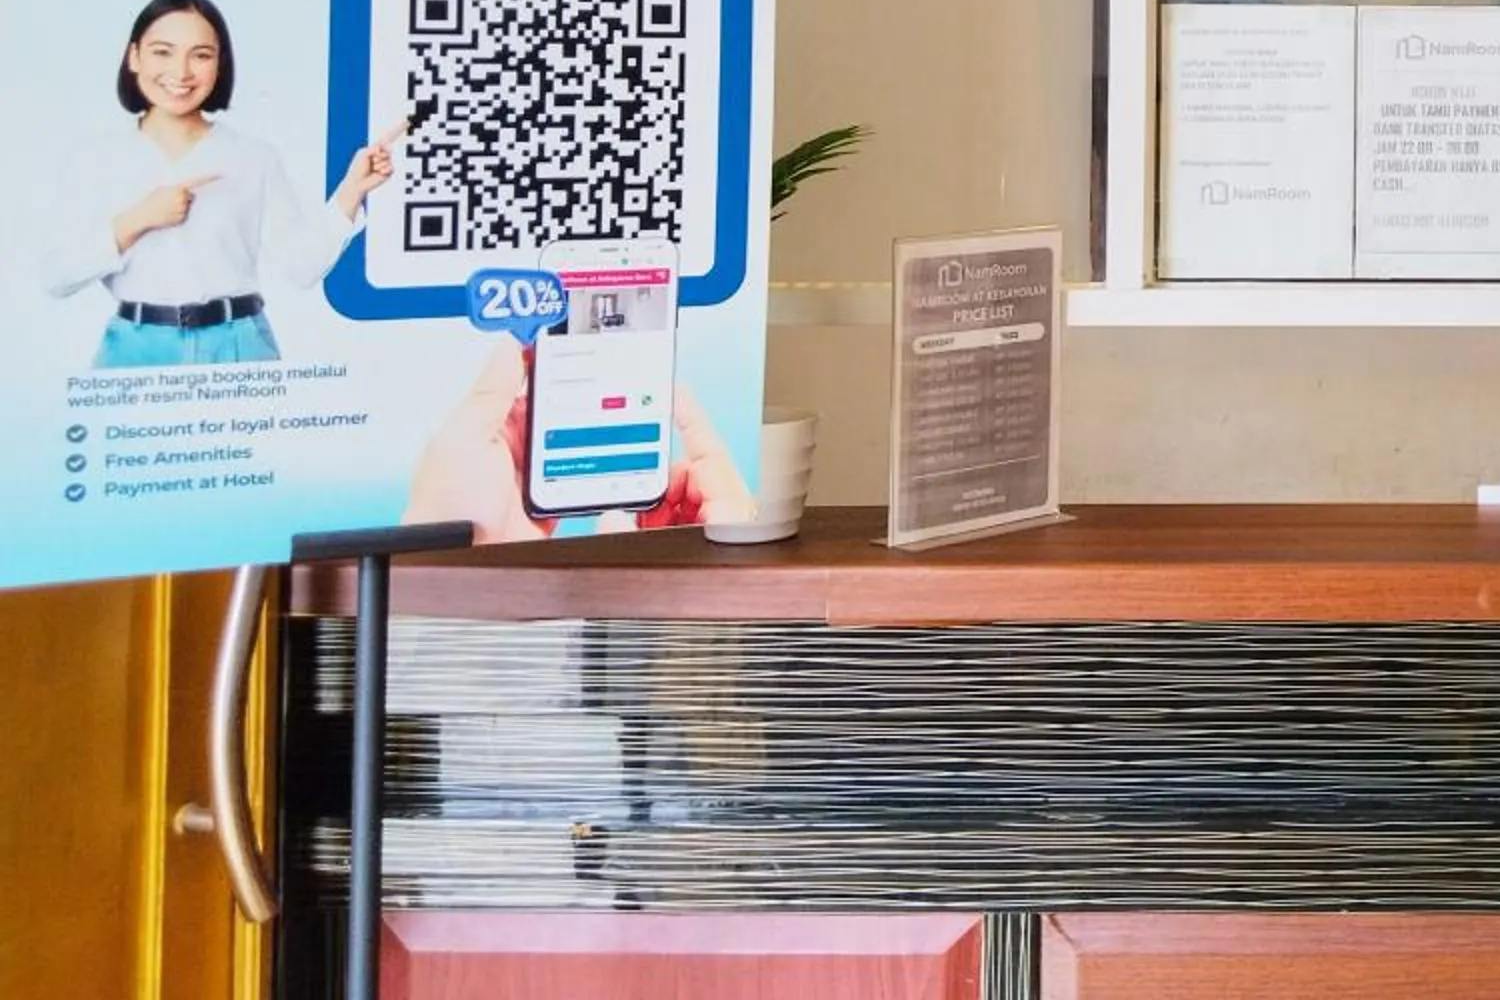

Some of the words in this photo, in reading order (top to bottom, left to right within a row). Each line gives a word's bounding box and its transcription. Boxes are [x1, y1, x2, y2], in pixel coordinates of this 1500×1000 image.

[479, 279, 560, 319] 20%
[536, 301, 563, 315] OFF
[67, 376, 156, 392] Potongan
[159, 370, 208, 388] harga
[212, 367, 283, 385] booking
[287, 364, 347, 380] melalui
[68, 391, 139, 408] website
[144, 389, 193, 404] resmi
[198, 385, 287, 400] NamRoom
[106, 422, 194, 440] Discount
[200, 419, 224, 435] for
[231, 416, 275, 436] loyal
[279, 412, 369, 429] costumer
[105, 452, 149, 468] Free
[153, 446, 253, 465] Amenities
[104, 477, 194, 498] Payment
[199, 475, 217, 489] at
[223, 471, 275, 488] Hotel
